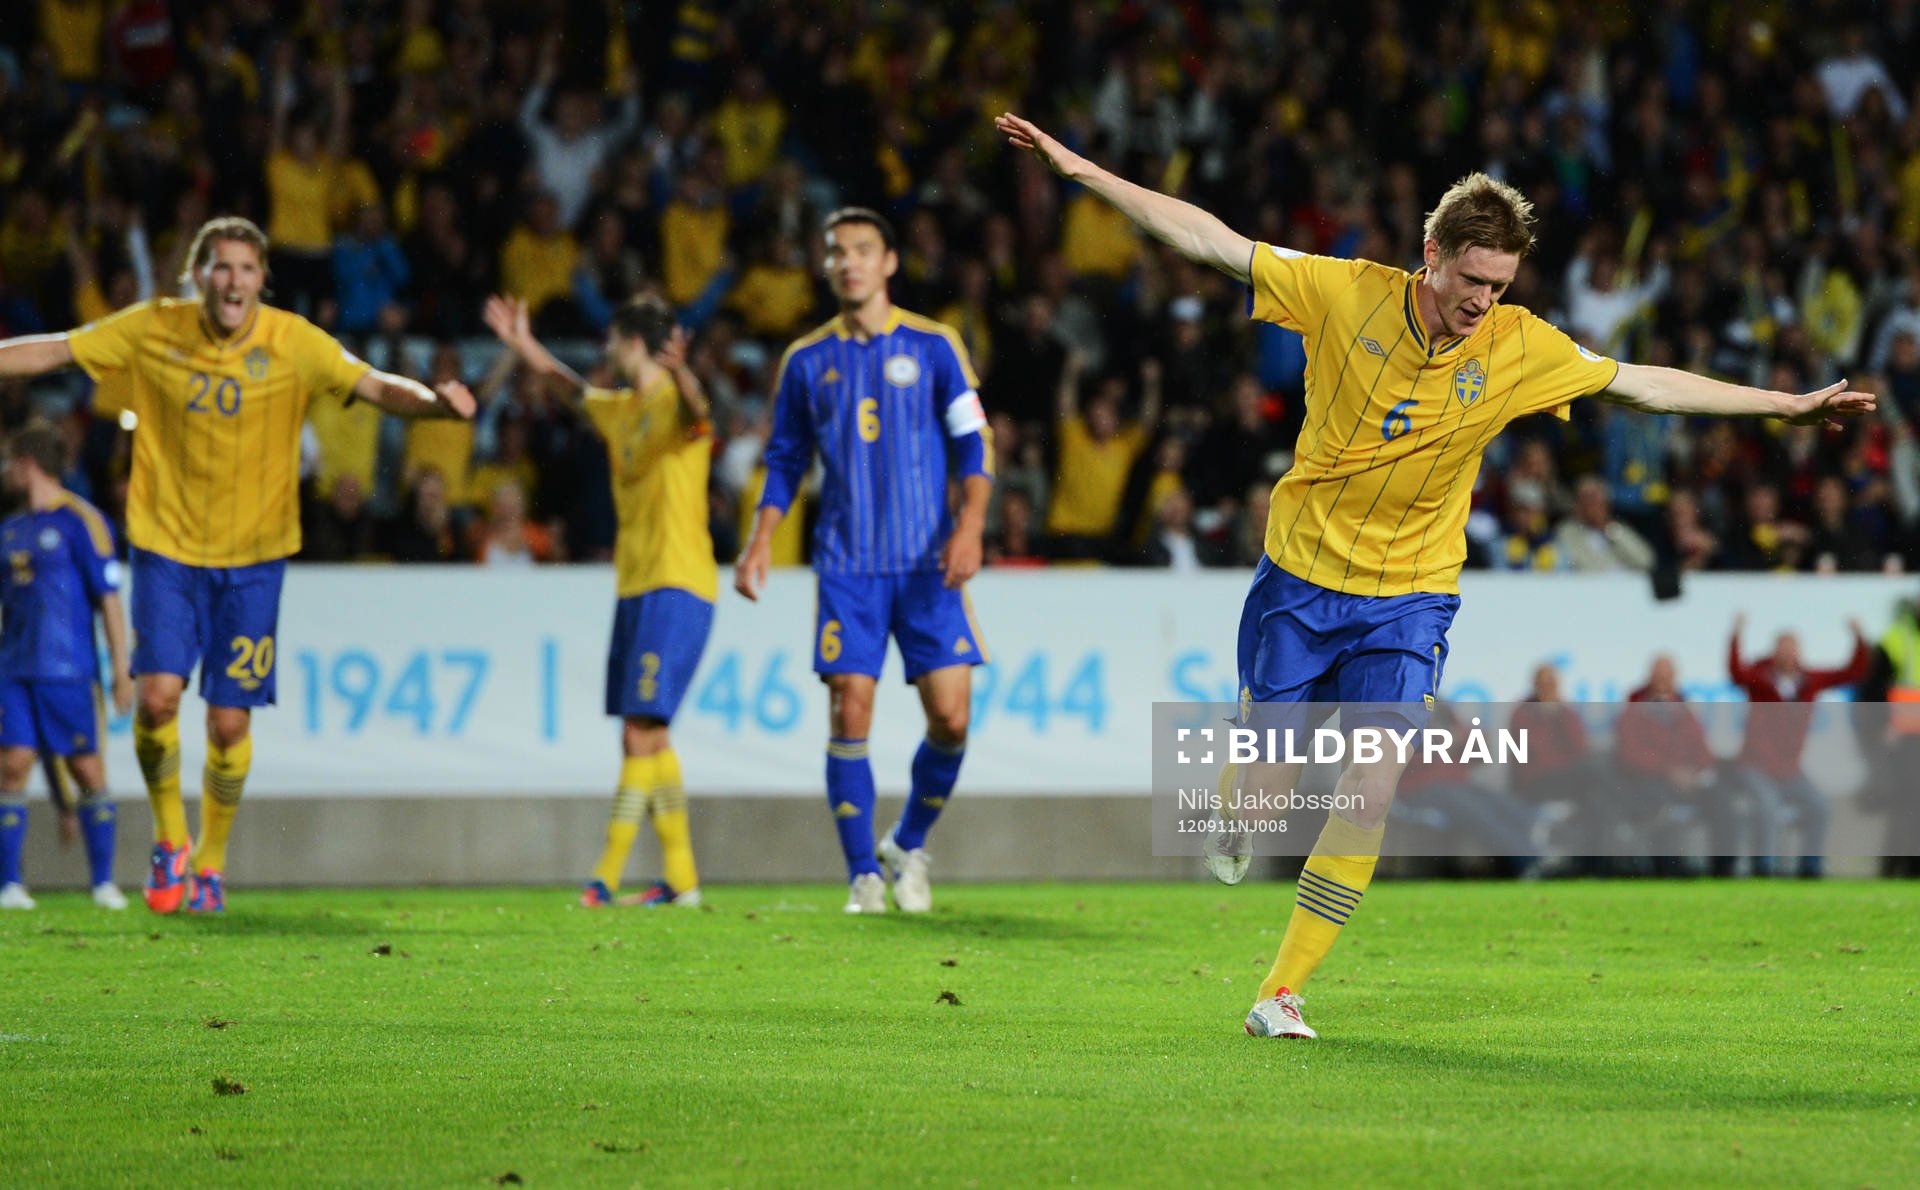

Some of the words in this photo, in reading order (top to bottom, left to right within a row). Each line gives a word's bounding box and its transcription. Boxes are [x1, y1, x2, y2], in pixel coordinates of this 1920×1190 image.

[187, 370, 241, 416] 20
[857, 398, 881, 442] 6
[1382, 400, 1419, 441] 6
[226, 635, 273, 679] 20
[820, 620, 842, 663] 6
[298, 648, 489, 733] 1947
